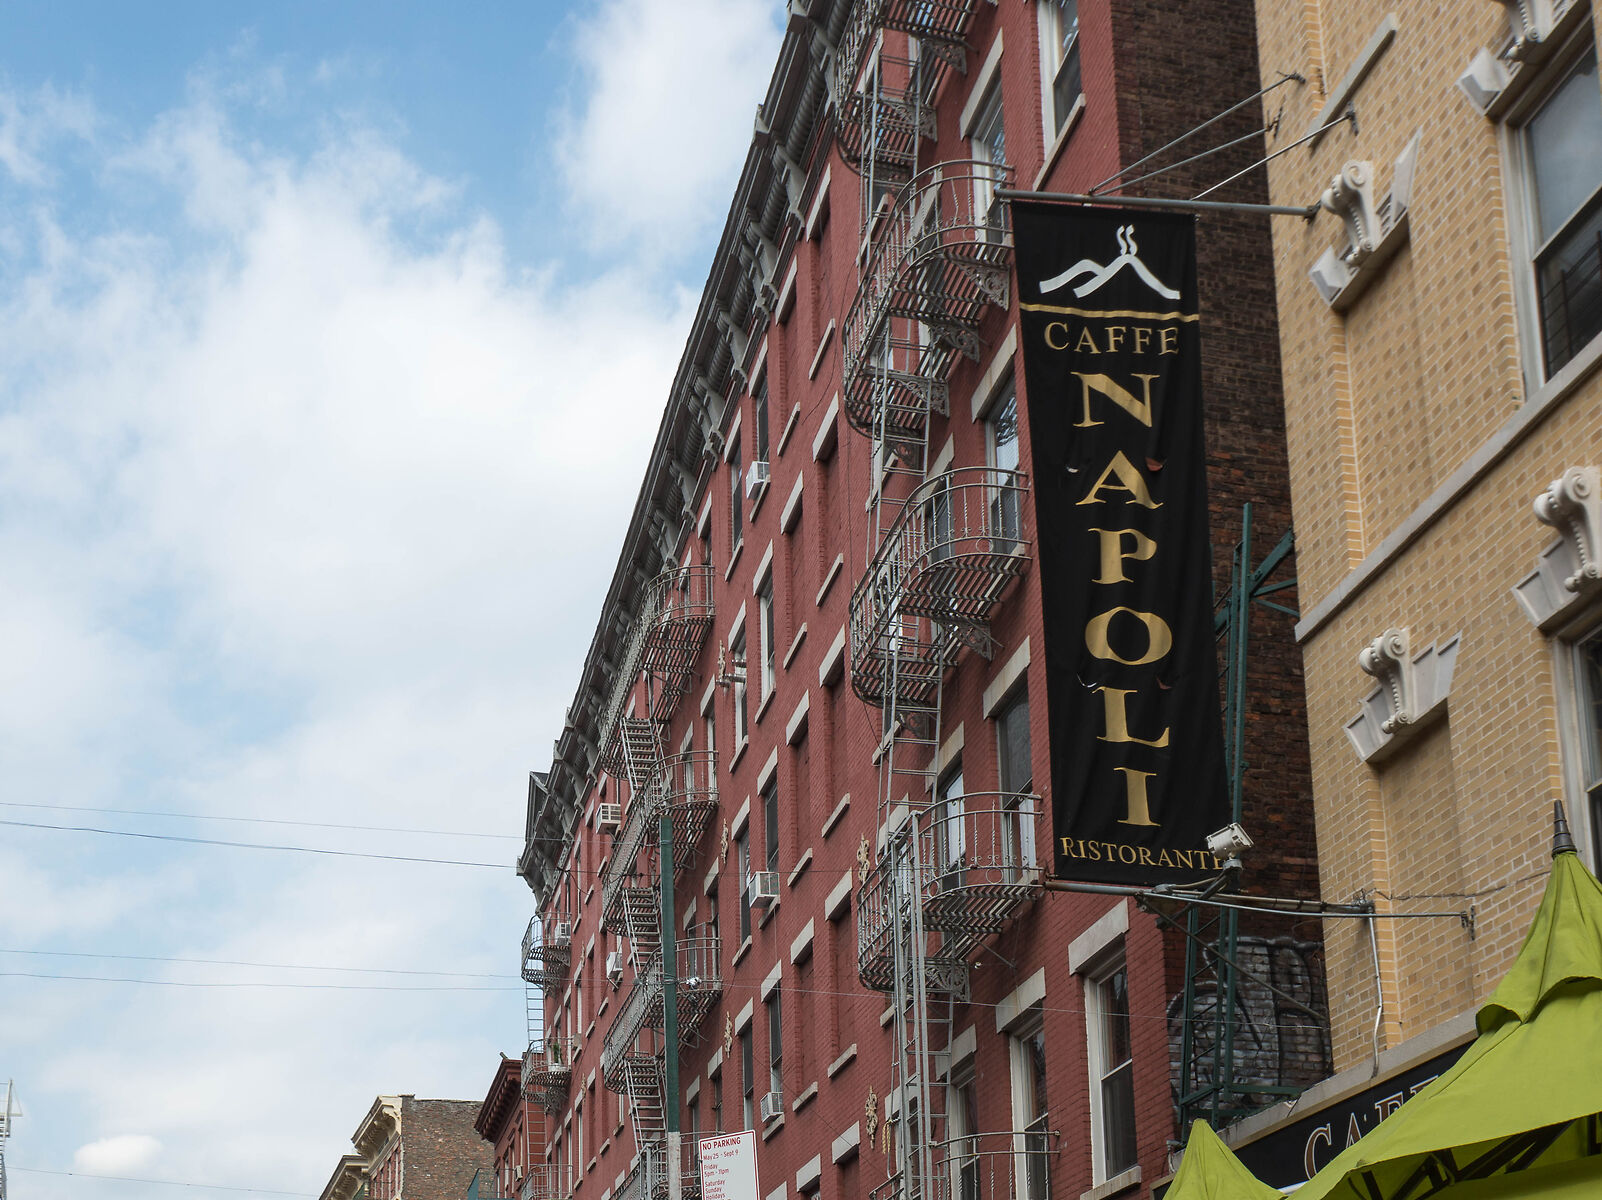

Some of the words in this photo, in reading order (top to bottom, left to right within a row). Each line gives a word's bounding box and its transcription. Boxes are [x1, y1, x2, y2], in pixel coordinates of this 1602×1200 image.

[1044, 321, 1180, 356] CAFFE
[1070, 371, 1173, 827] NAPOLI
[702, 1141, 712, 1150] NO
[713, 1137, 741, 1149] PARKING
[713, 1152, 719, 1160] 25
[723, 1150, 734, 1158] Sept
[704, 1170, 715, 1178] 5pm
[706, 1193, 725, 1200] Holidays
